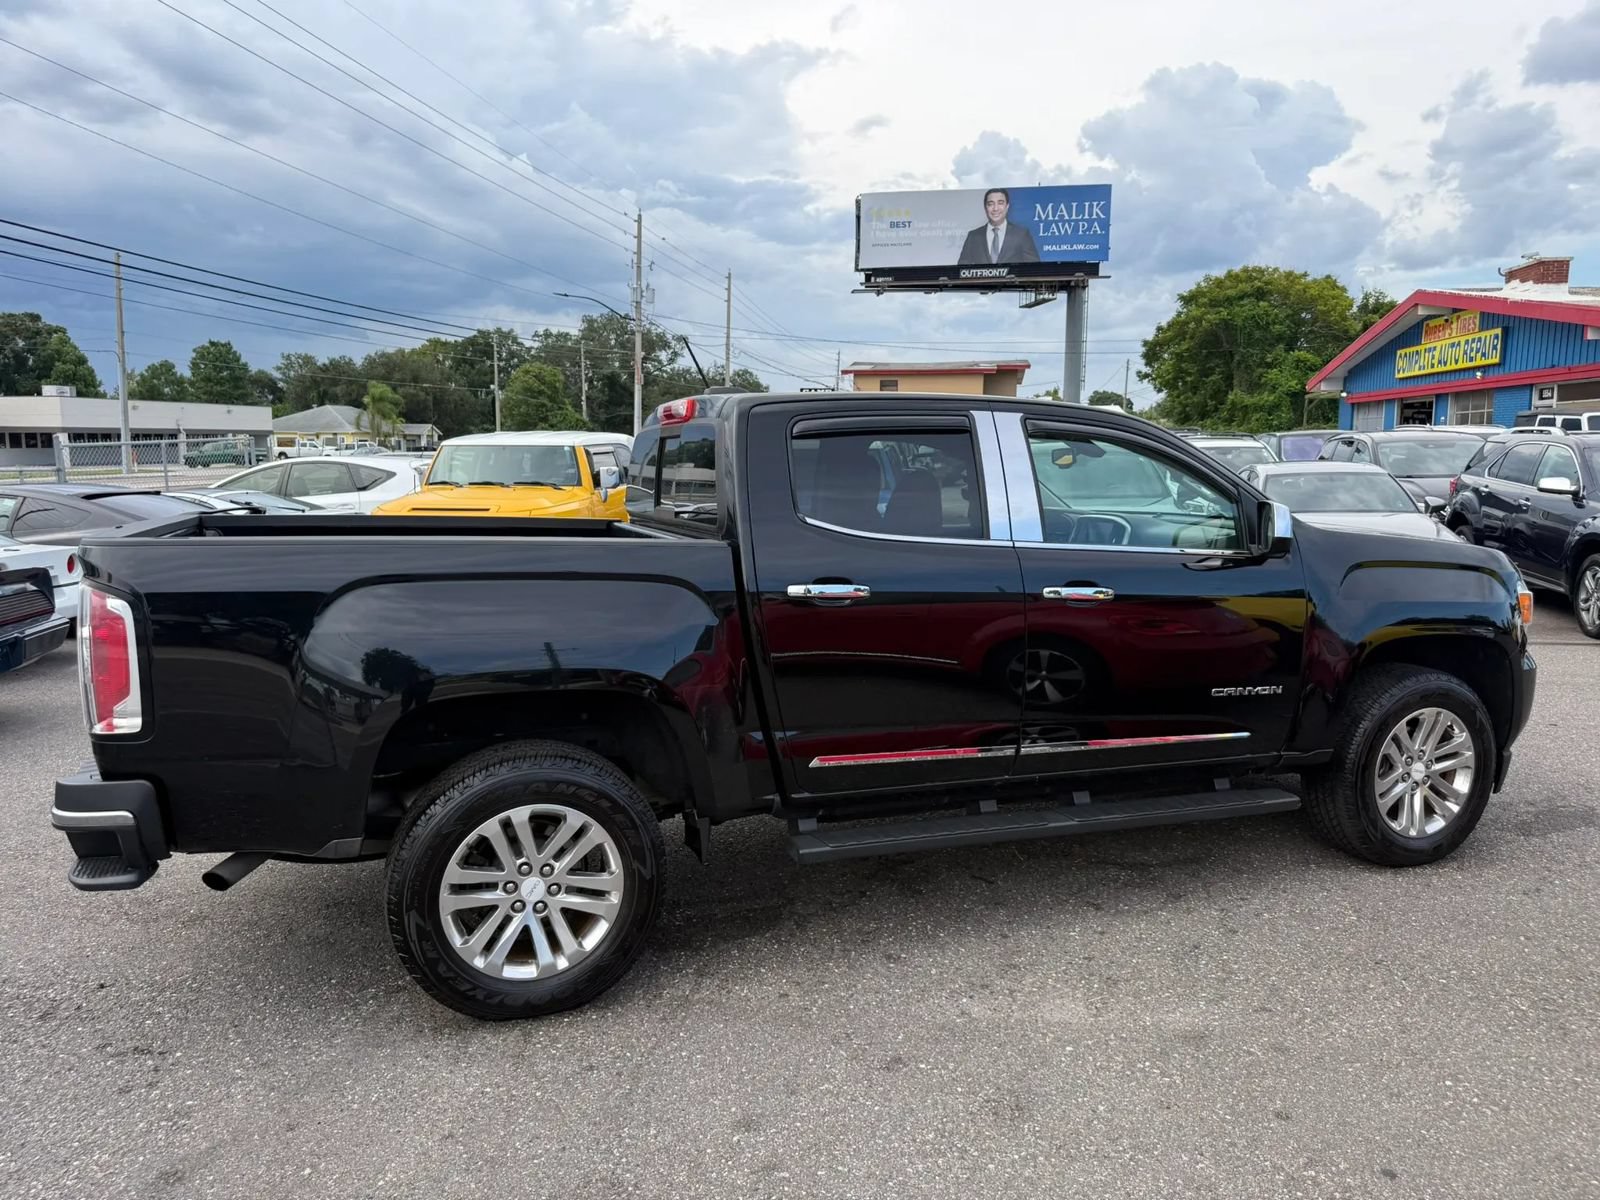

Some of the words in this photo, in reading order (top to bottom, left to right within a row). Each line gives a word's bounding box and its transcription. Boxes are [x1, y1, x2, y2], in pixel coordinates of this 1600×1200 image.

[1033, 201, 1106, 221] MALIK
[889, 221, 912, 230] BEST
[1039, 222, 1074, 236] LAW
[1078, 221, 1105, 235] P.A.
[1455, 313, 1477, 335] TIRES
[1396, 345, 1437, 374] COMPLETE
[1437, 340, 1461, 368] AUTO
[1462, 333, 1500, 364] REPAIR
[1211, 685, 1283, 696] CANYON
